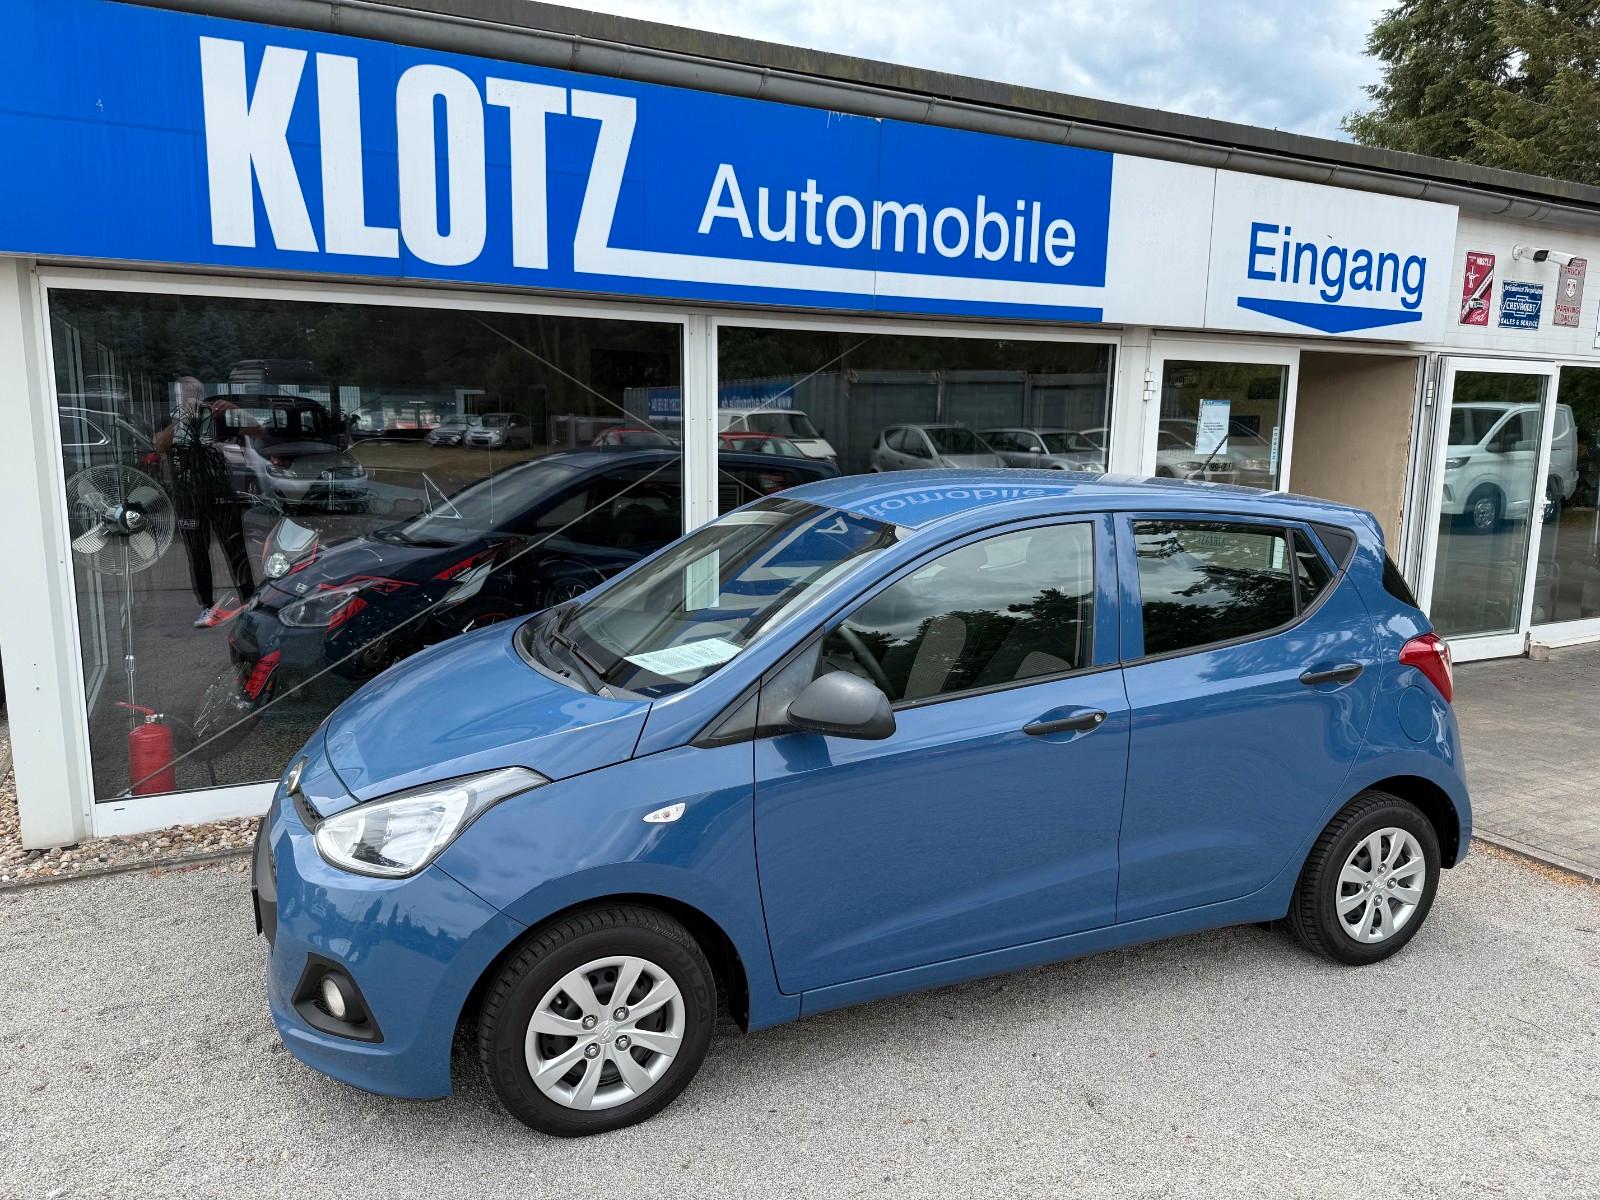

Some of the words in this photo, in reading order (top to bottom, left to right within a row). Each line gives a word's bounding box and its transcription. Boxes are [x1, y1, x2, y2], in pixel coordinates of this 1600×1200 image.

[199, 36, 639, 276] KLOTZ
[697, 163, 1077, 269] Automobile
[1247, 221, 1427, 311] Eingang
[1505, 301, 1537, 312] CHEVROLET
